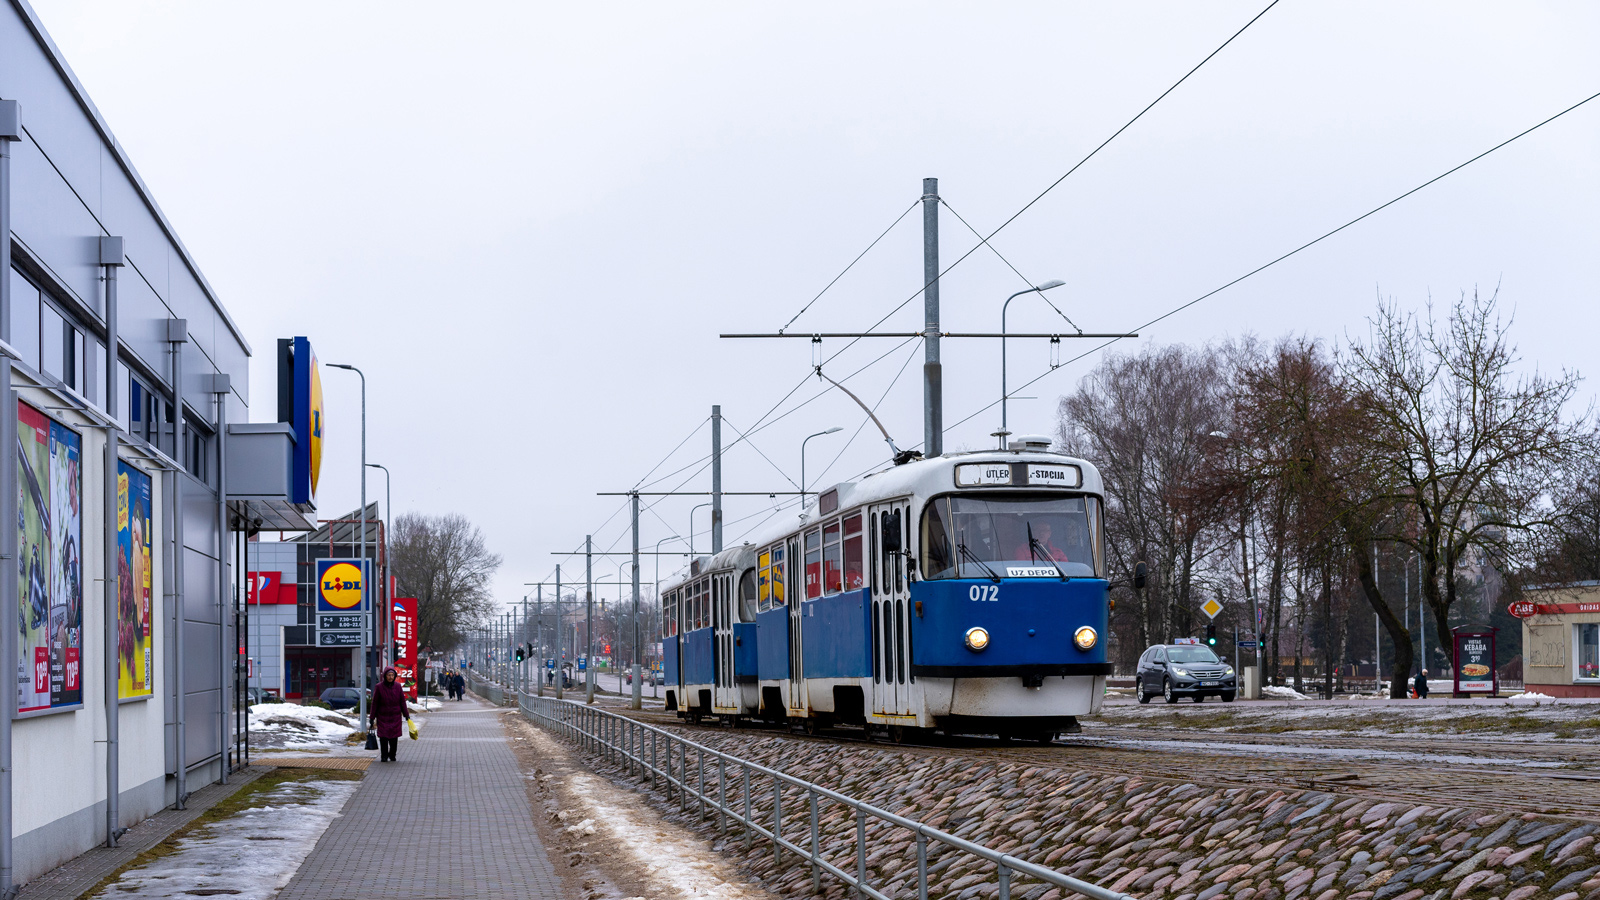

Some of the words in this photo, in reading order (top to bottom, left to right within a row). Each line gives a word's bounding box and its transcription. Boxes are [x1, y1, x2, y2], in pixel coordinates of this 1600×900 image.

[1029, 470, 1064, 480] -STACIJA
[324, 577, 361, 592] LIDL
[969, 585, 999, 601] 072
[396, 670, 413, 678] -22
